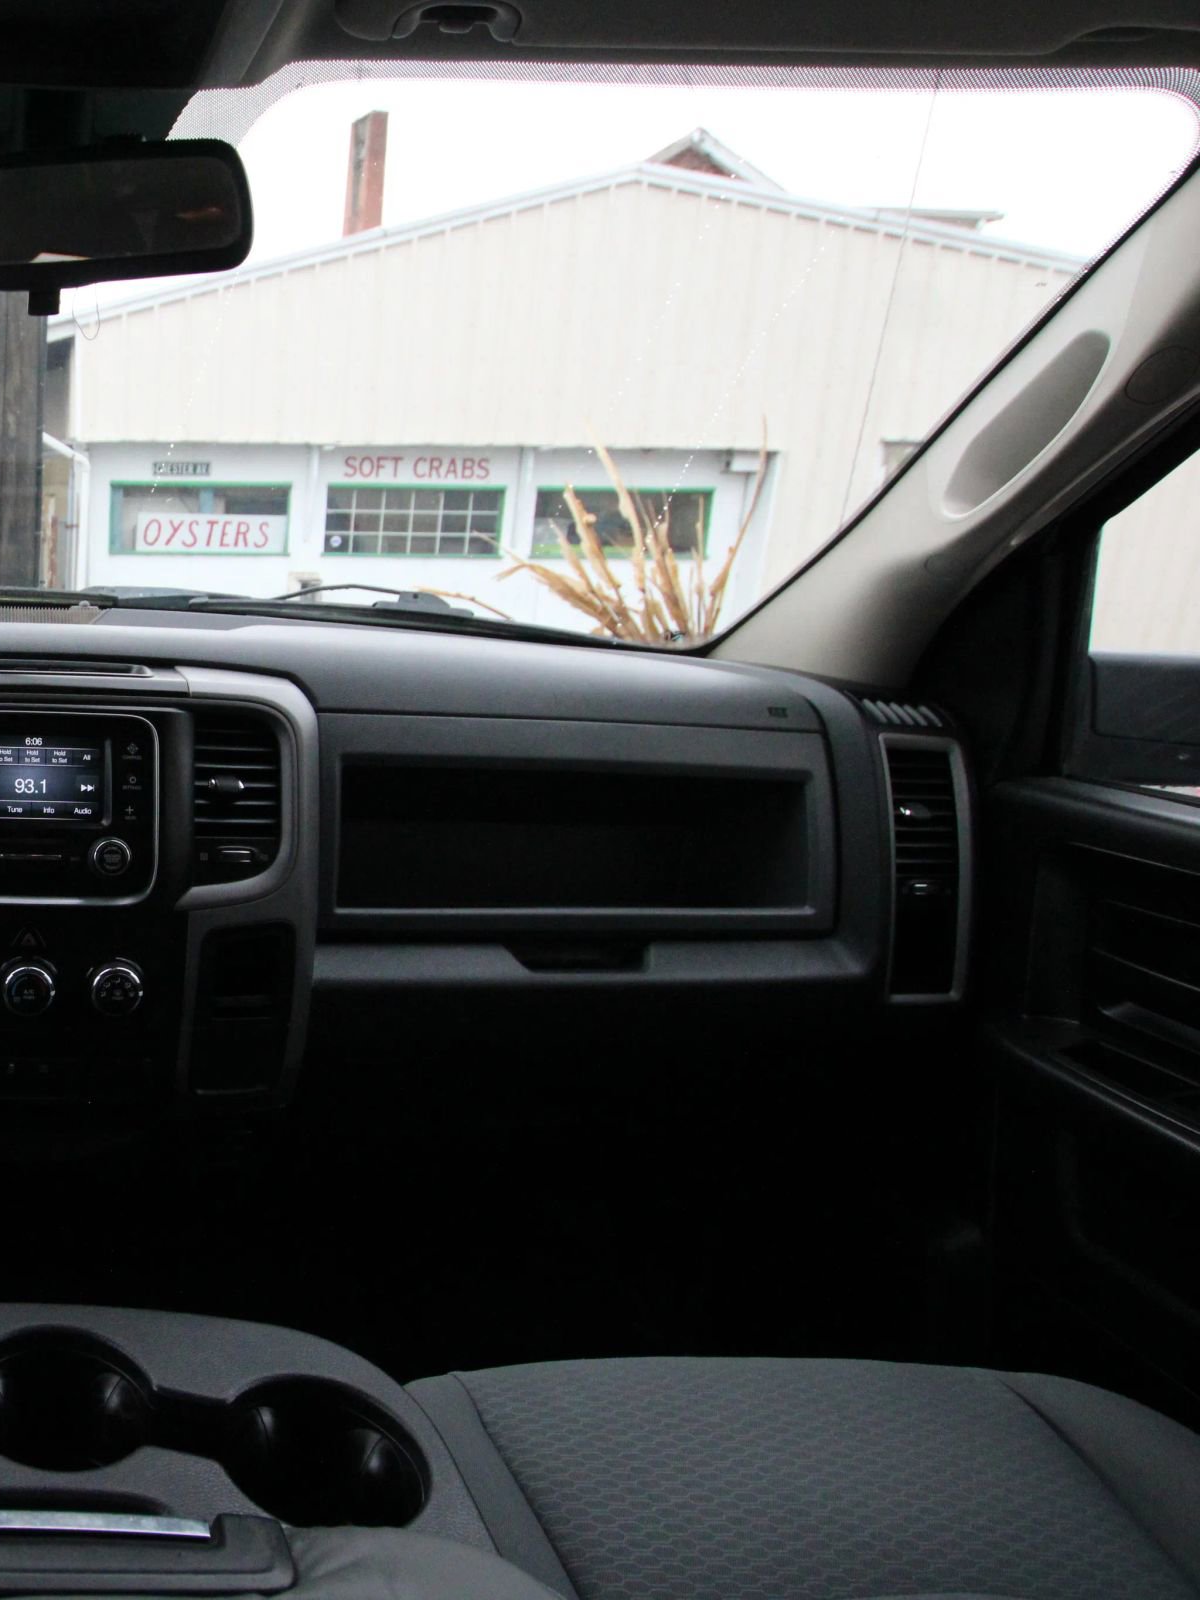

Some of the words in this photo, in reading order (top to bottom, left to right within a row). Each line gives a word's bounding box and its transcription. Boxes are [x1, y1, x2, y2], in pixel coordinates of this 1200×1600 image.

[343, 456, 403, 478] SOFT
[412, 456, 491, 480] CRABS
[142, 518, 270, 549] OYSTERS
[25, 737, 43, 746] 6:06
[15, 778, 47, 794] 93.1
